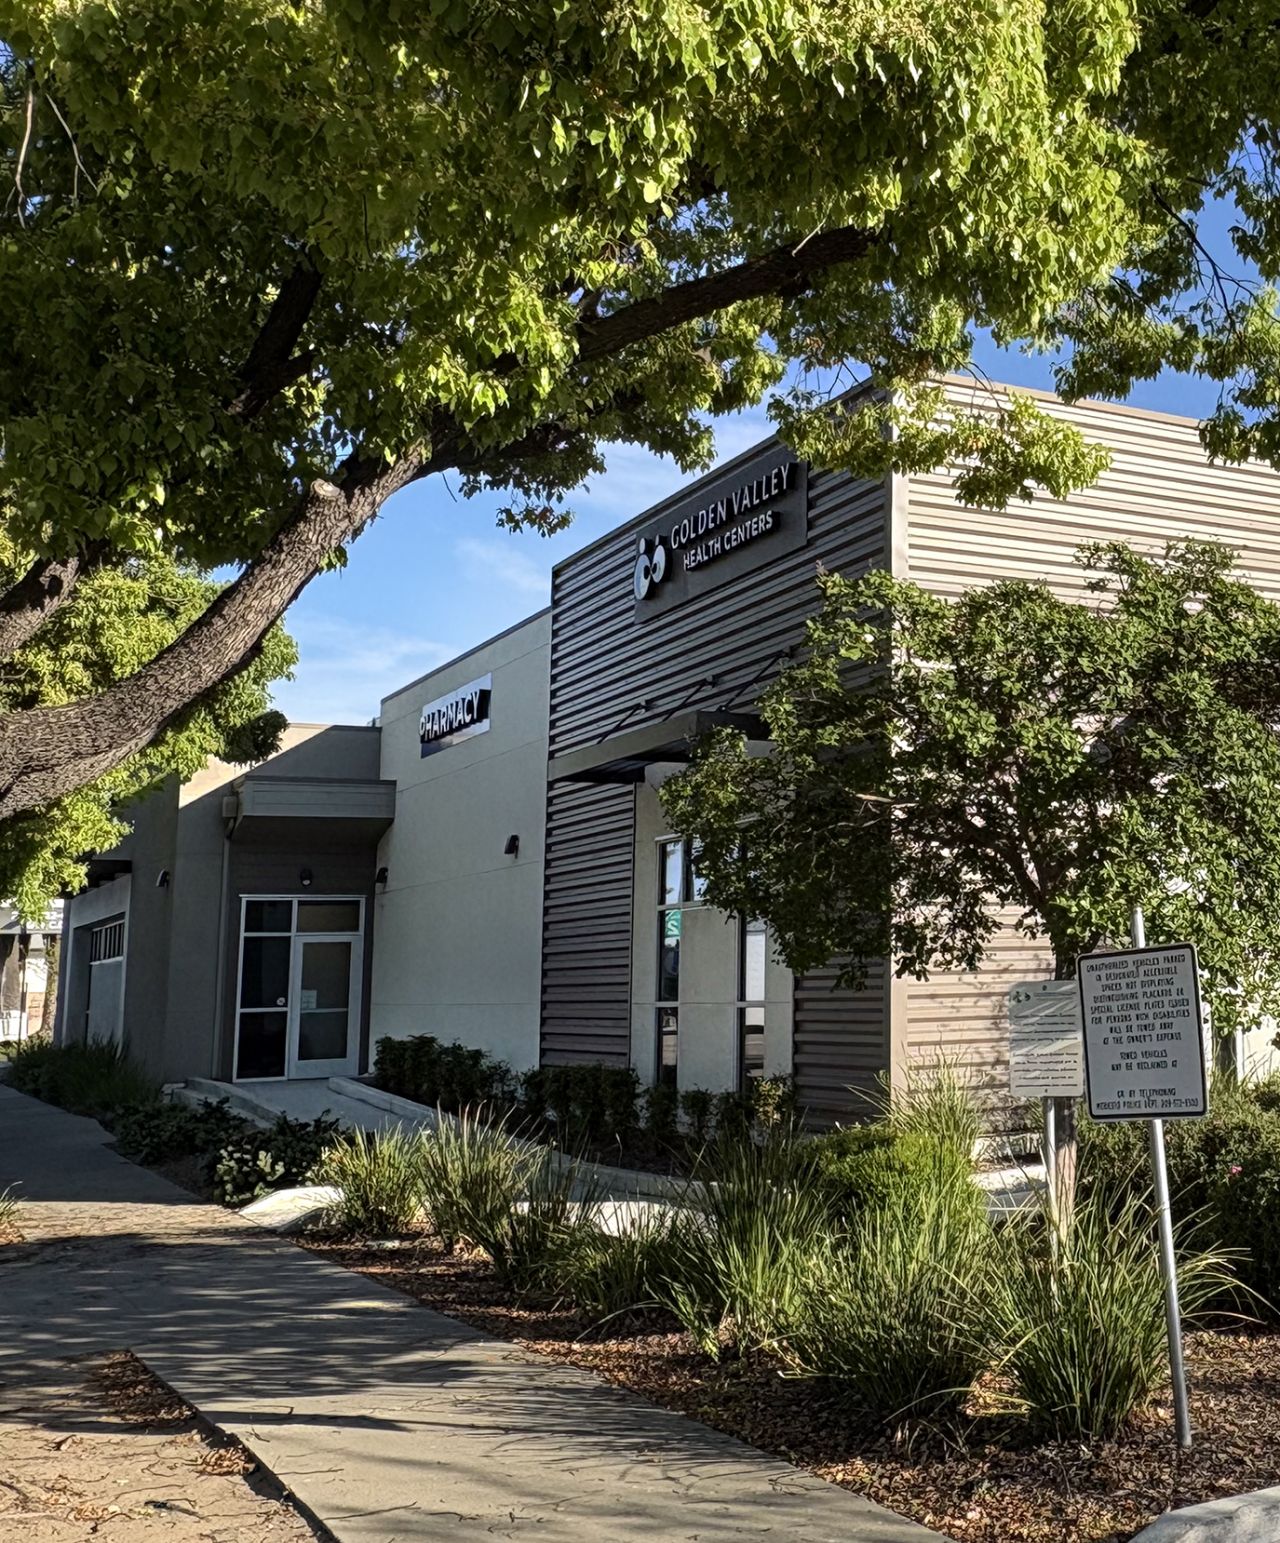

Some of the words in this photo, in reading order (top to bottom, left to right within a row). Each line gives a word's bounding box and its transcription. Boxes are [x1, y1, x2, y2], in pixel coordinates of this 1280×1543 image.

[671, 498, 727, 550] GOLDEN
[731, 462, 790, 516] VALLEY
[683, 537, 722, 572] HEALTH
[723, 510, 774, 551] CENTERS
[419, 690, 481, 741] PHARMACY
